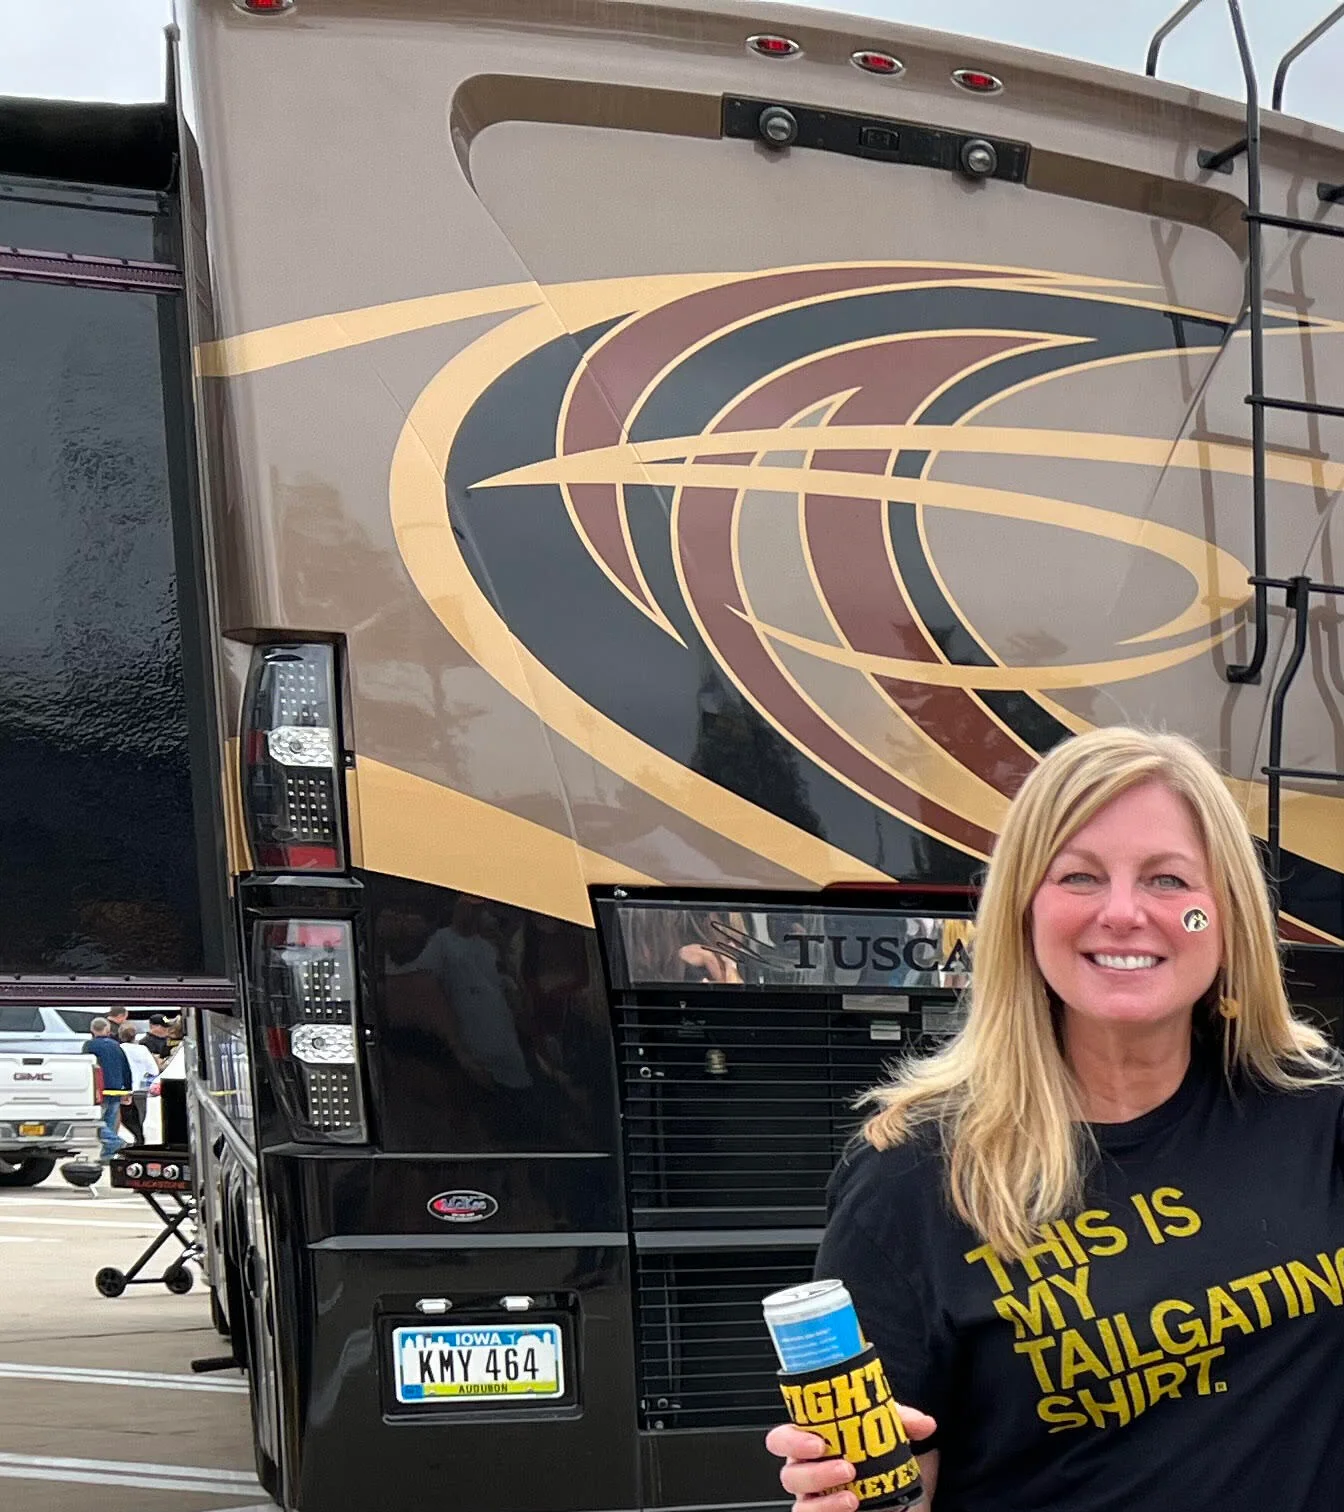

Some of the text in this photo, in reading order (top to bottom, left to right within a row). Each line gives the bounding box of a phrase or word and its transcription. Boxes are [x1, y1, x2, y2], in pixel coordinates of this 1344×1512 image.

[963, 1186, 1202, 1293] THIS IS
[993, 1266, 1096, 1339] MY
[455, 1333, 503, 1346] IOWA
[418, 1348, 540, 1384] KMY 464
[458, 1383, 508, 1394] AUDUBON
[837, 1397, 909, 1463] IO
[823, 1457, 920, 1500] KEYES
